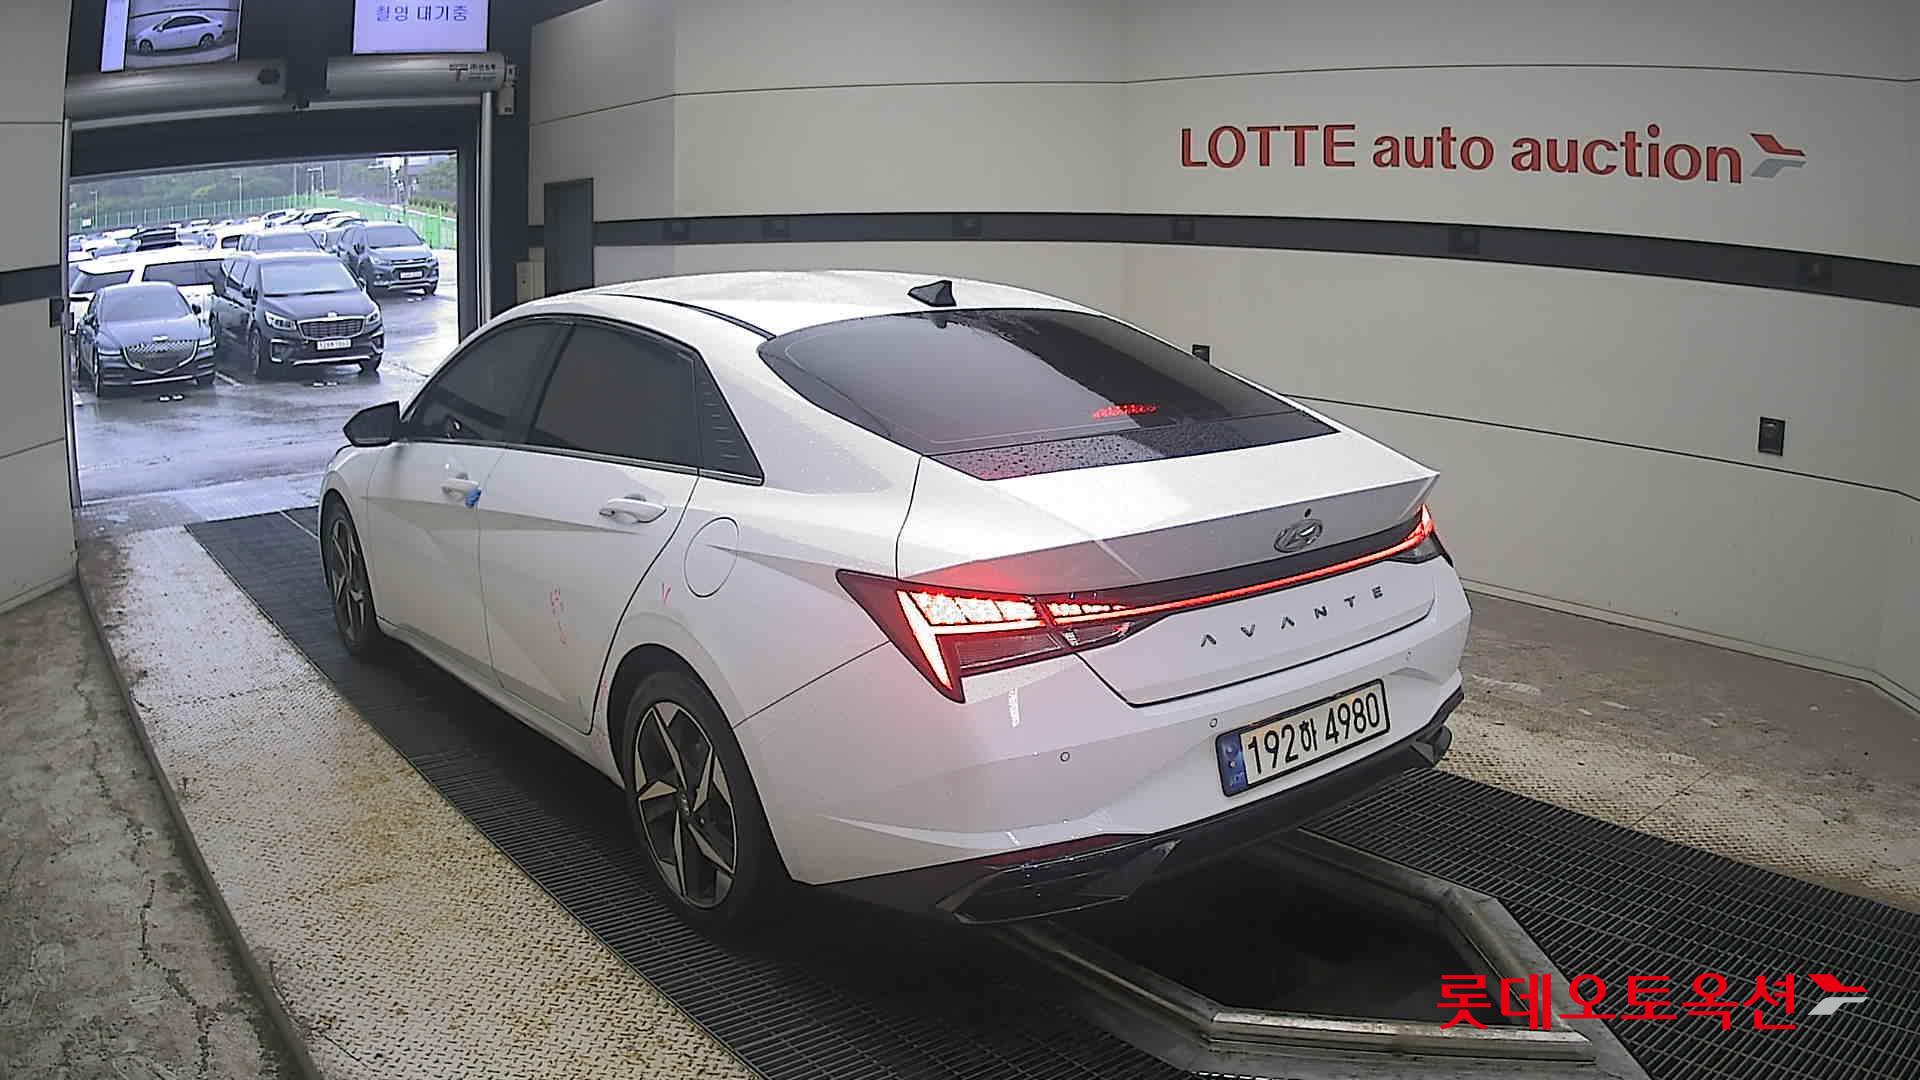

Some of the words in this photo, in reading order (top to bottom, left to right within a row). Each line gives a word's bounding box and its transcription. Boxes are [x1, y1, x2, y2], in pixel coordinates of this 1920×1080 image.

[416, 5, 468, 22] 대기중
[1180, 124, 1356, 169] LOTTE
[1372, 126, 1495, 171] auto
[1511, 124, 1743, 185] auction
[1200, 586, 1384, 648] AVANTE
[1247, 717, 1319, 775] 192하
[1325, 692, 1381, 745] 4980
